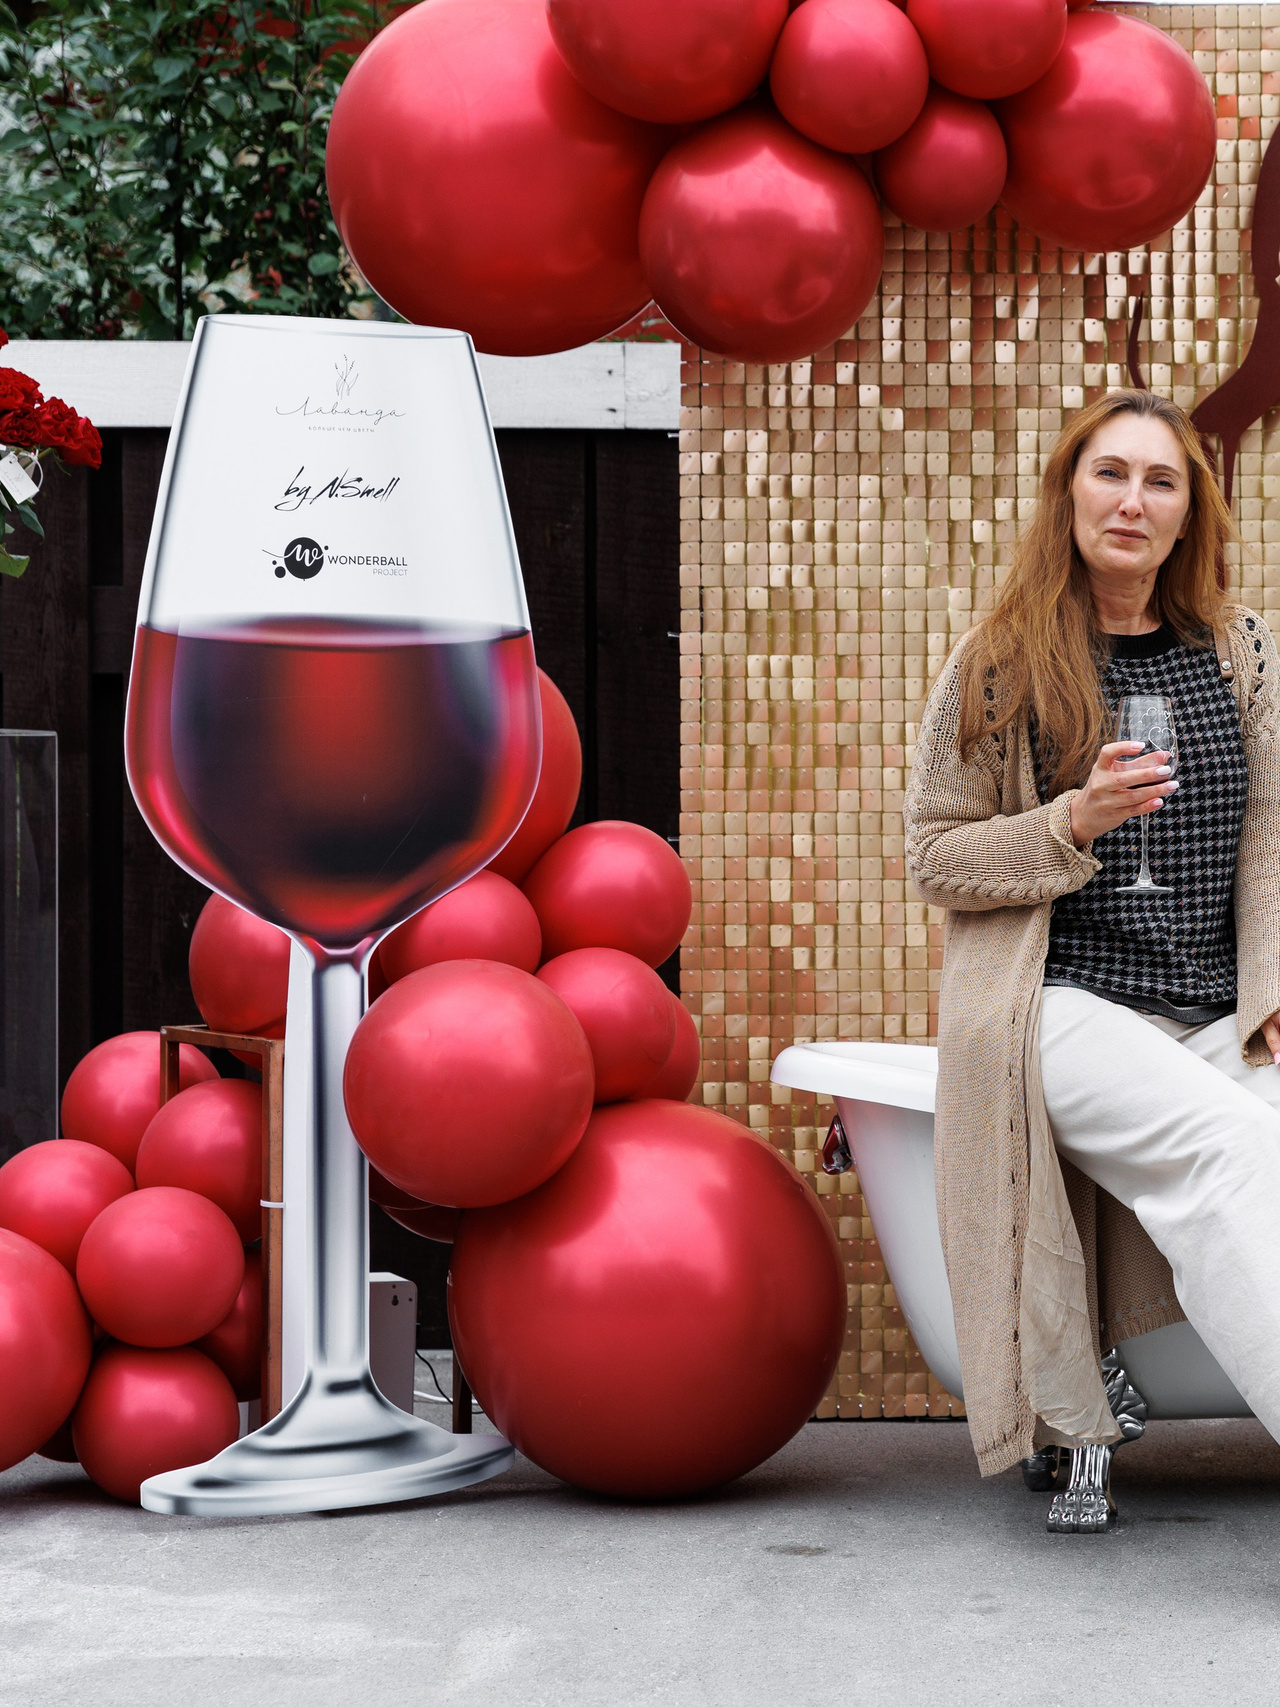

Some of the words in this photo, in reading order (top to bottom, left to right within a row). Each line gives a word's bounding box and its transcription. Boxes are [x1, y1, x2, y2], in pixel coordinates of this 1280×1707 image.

[276, 396, 406, 426] Лаванда
[274, 465, 311, 511] by
[309, 467, 400, 505] N.Smell
[328, 555, 408, 567] WONDERBALL
[372, 568, 408, 577] PROJECT
